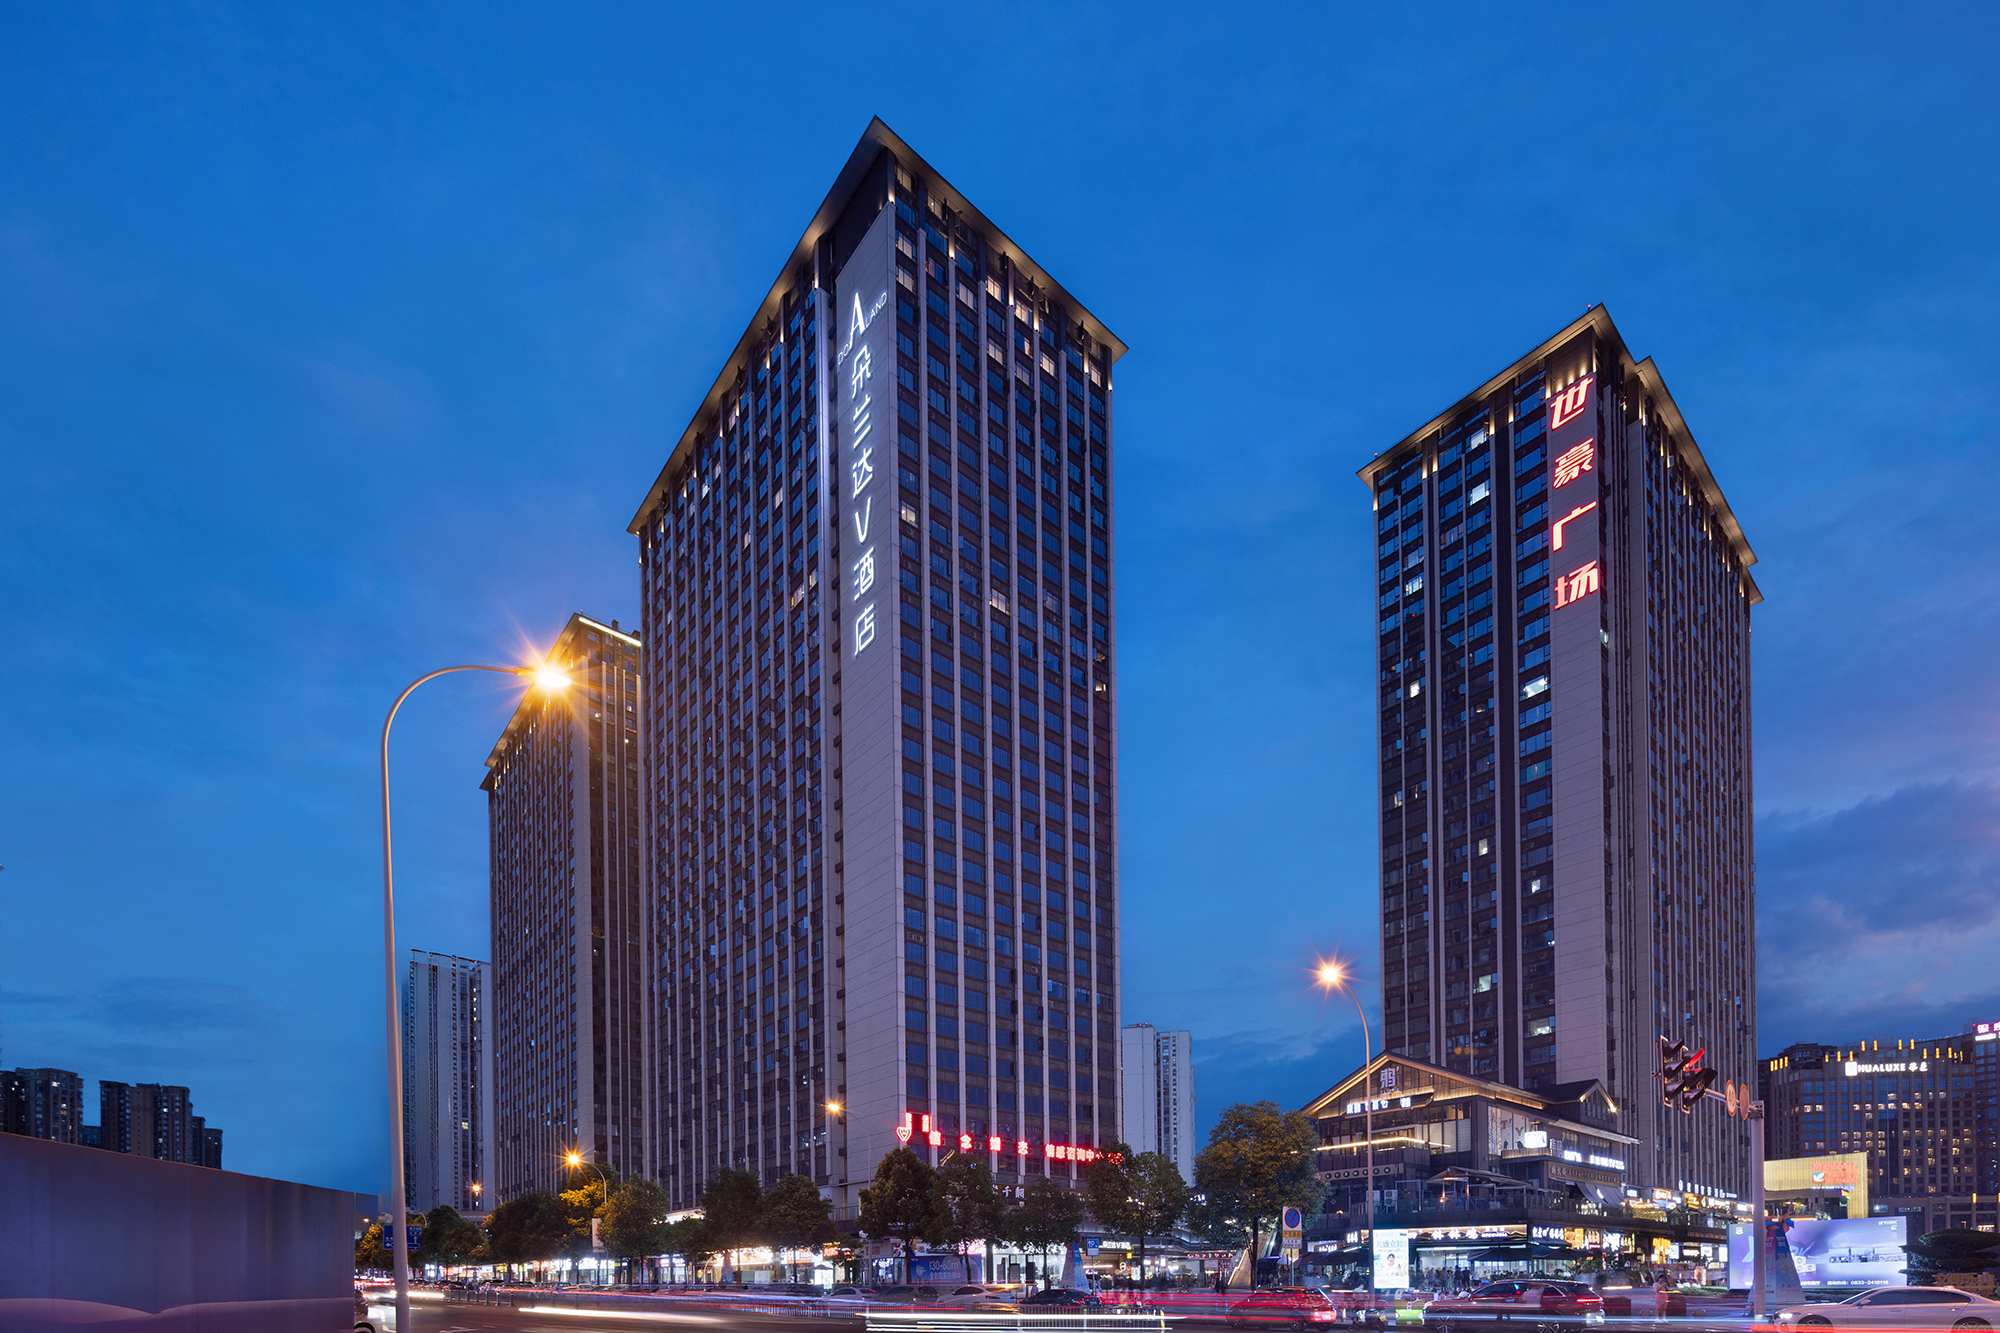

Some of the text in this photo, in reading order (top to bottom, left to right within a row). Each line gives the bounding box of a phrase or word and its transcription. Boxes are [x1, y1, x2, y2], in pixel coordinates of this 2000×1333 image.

[1550, 377, 1599, 610] 世豪广场
[1858, 1063, 1906, 1073] HUALUXE
